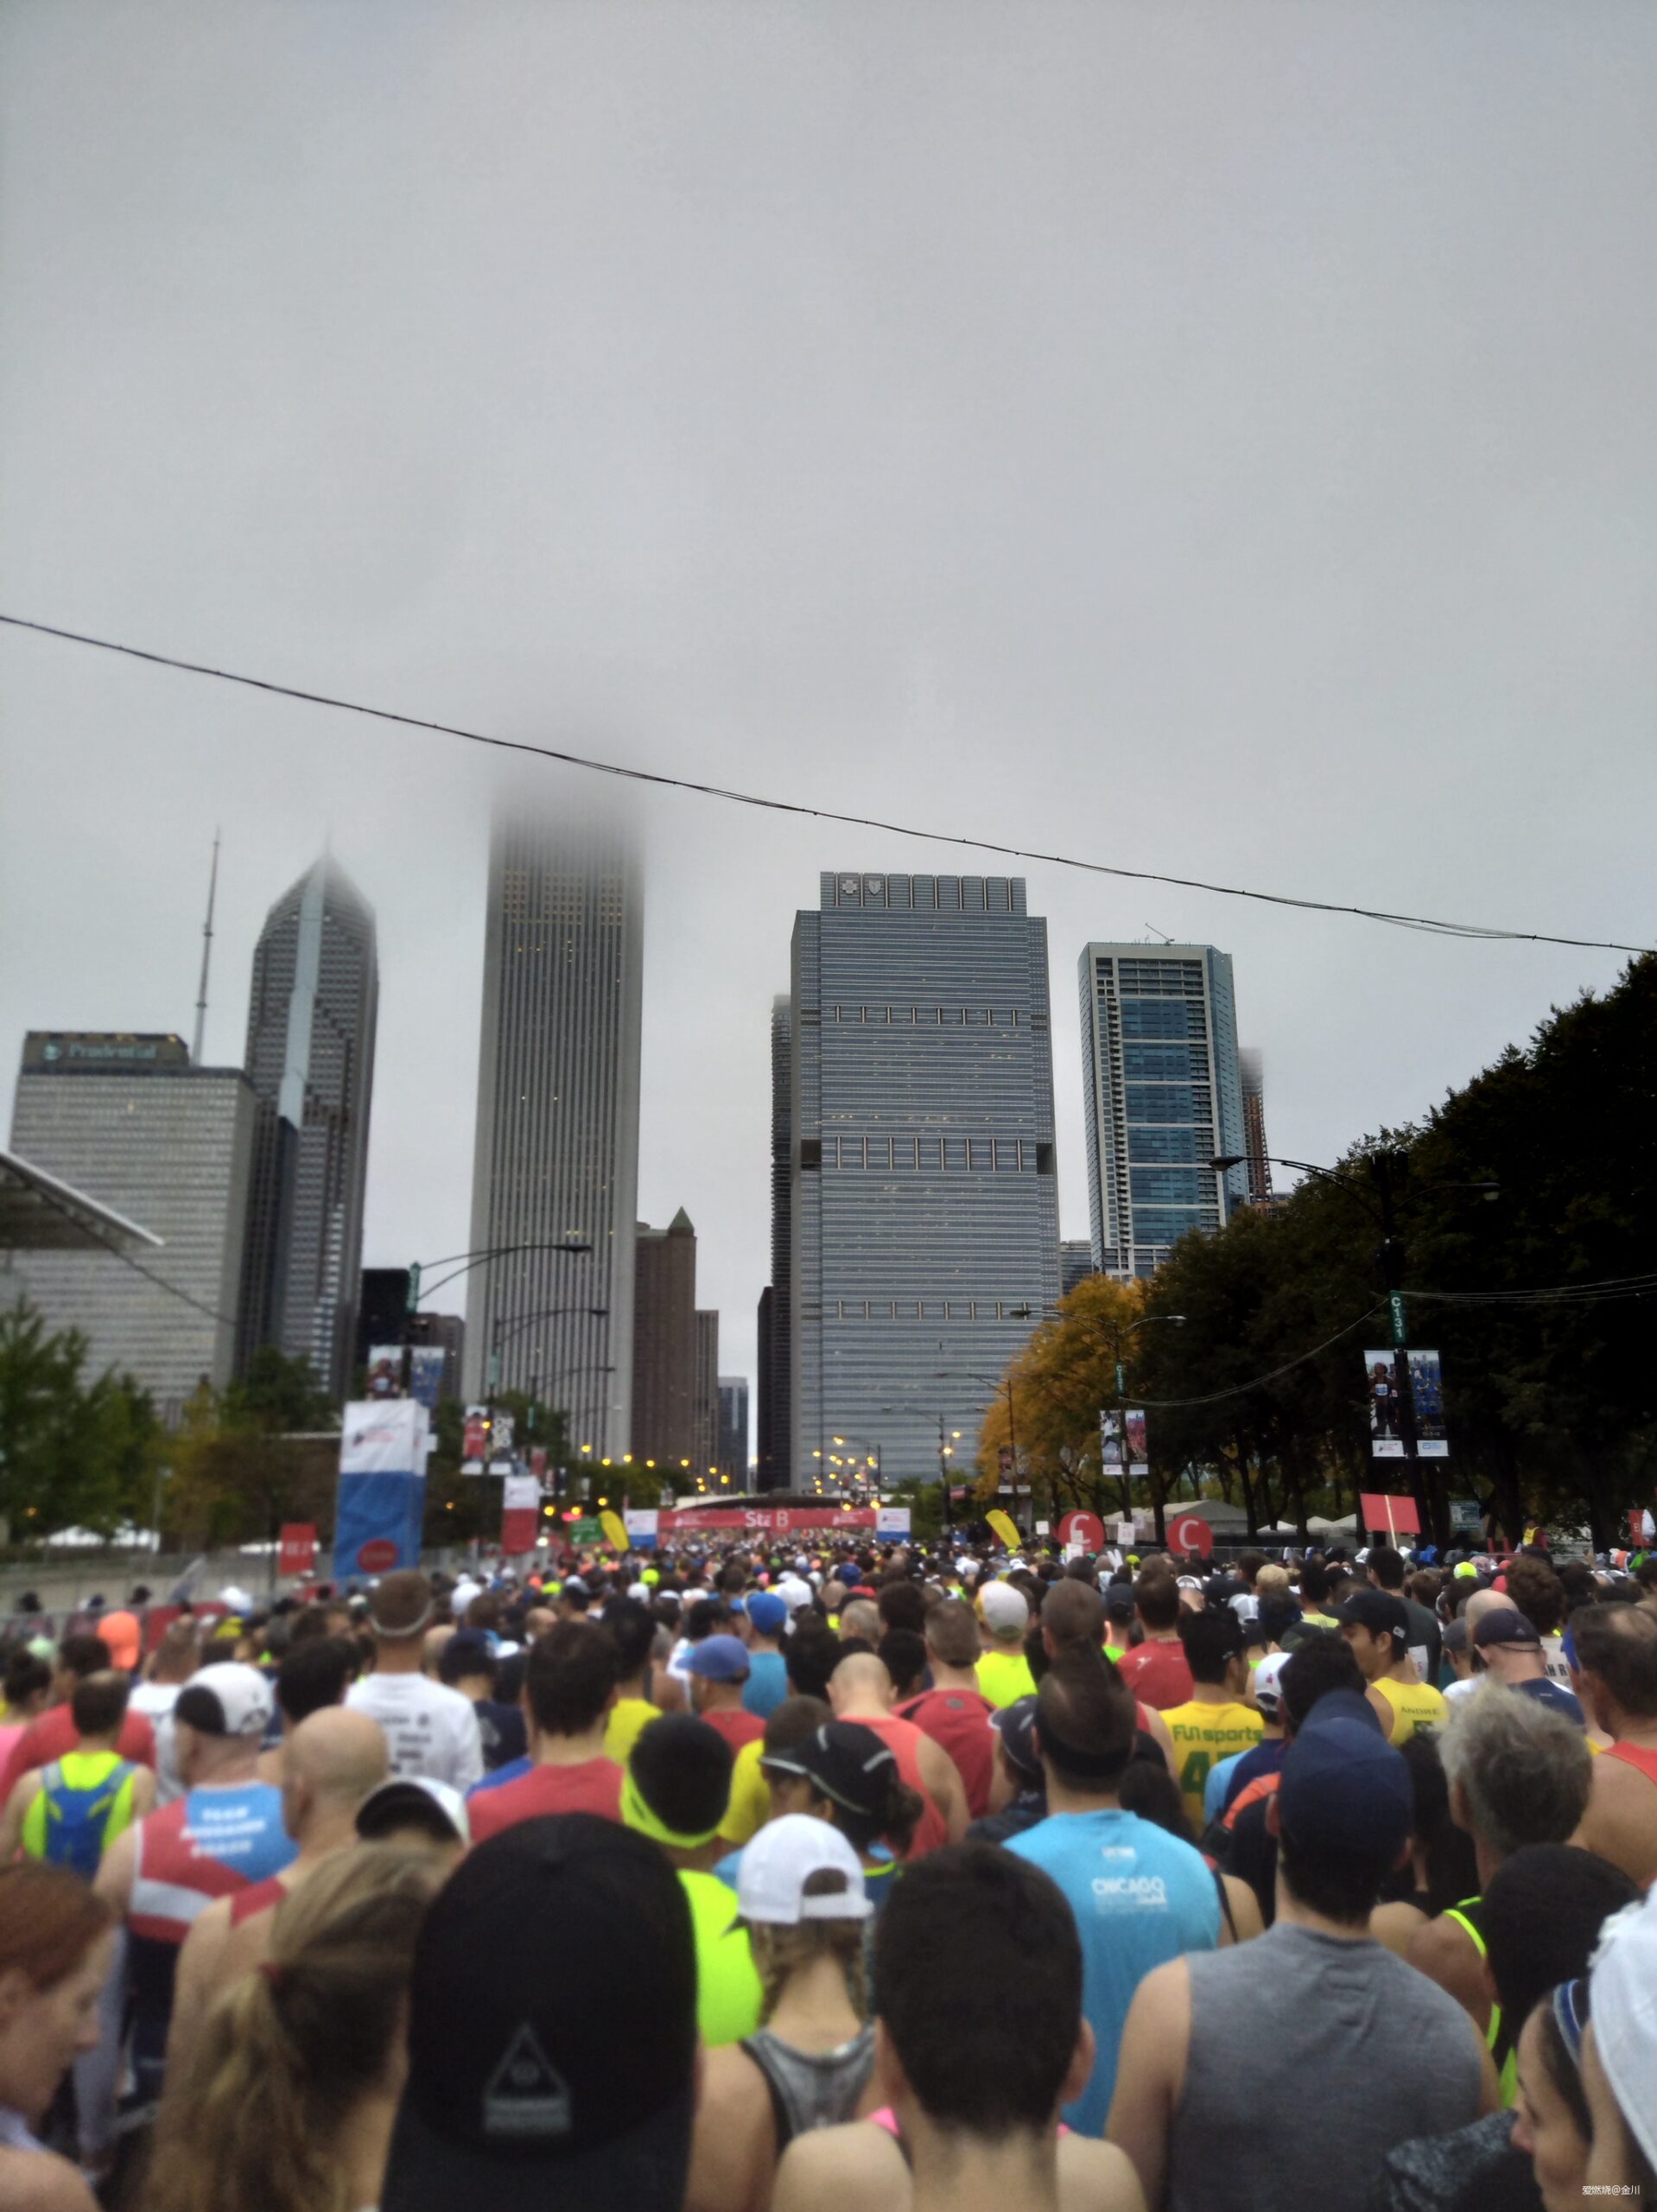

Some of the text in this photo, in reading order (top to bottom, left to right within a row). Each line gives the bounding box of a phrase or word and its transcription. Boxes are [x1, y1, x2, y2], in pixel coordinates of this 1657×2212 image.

[1391, 1297, 1404, 1338] C131
[745, 1510, 771, 1528] Sta
[1178, 1519, 1199, 1550] C
[1091, 1876, 1165, 1895] CHICAGO
